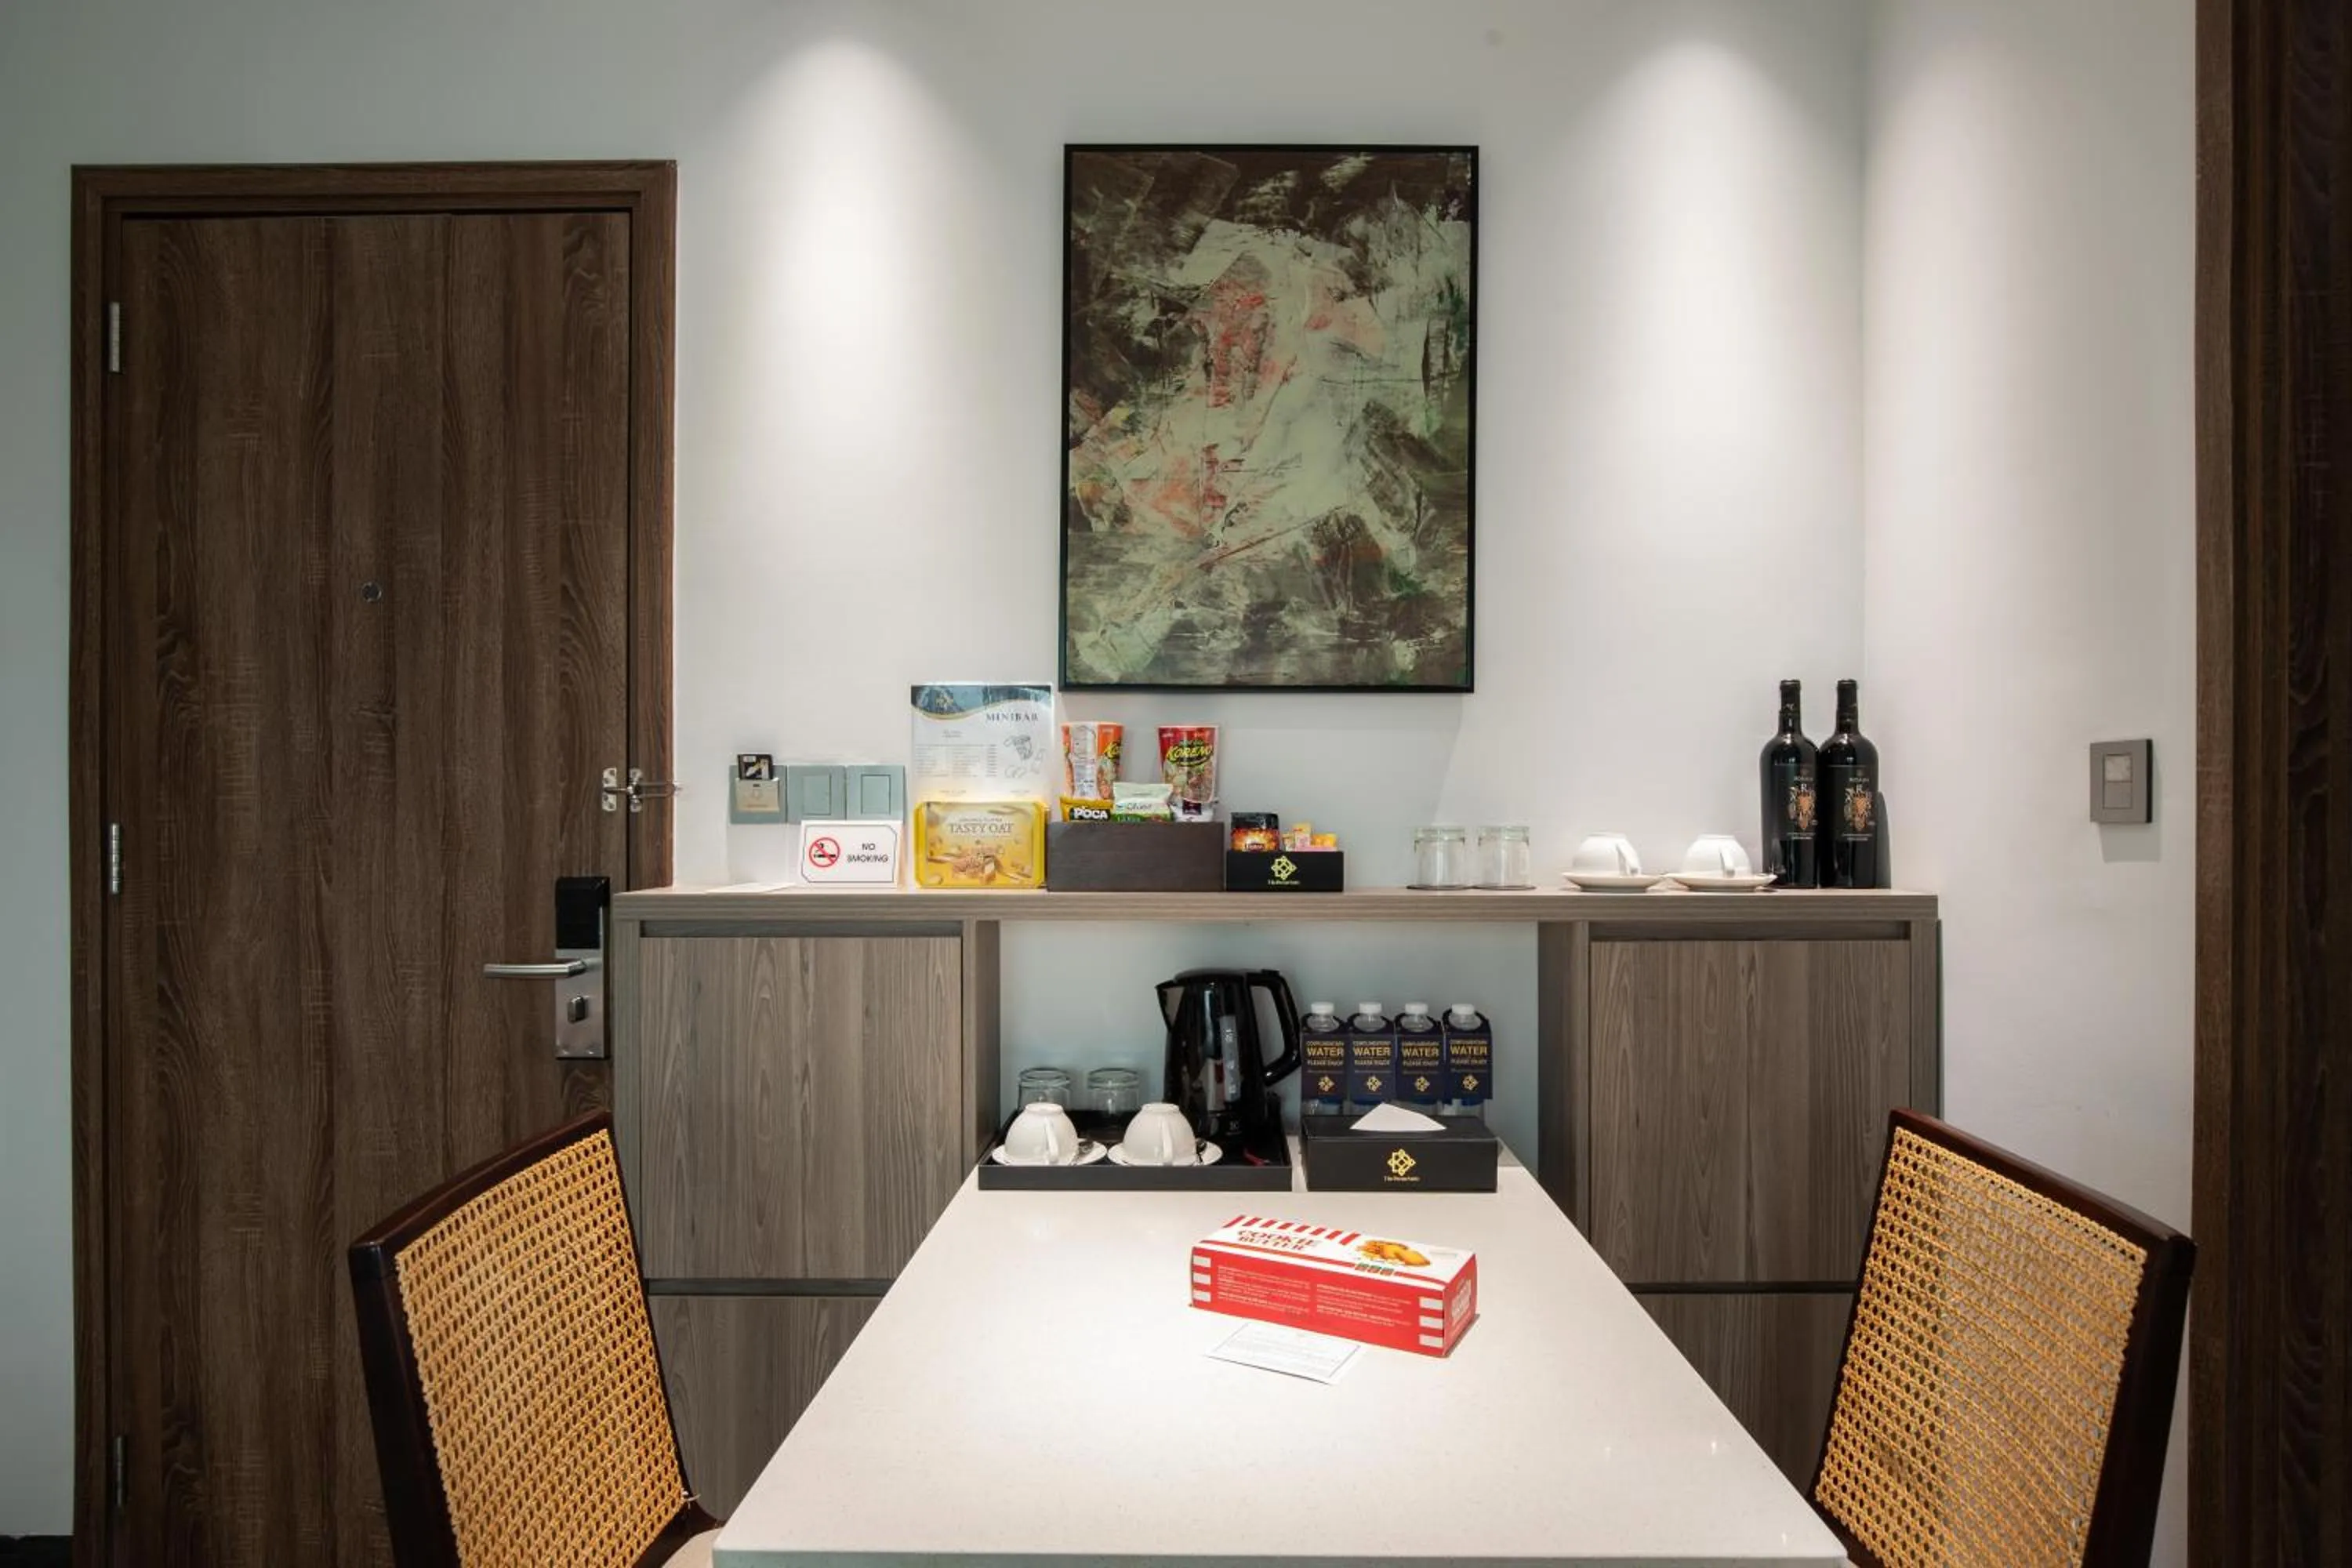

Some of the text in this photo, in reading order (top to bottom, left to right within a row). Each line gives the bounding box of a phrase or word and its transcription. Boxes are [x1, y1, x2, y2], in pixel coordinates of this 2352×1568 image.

[985, 712, 1039, 722] MINIBAR
[948, 822, 1014, 833] TASTY OAT
[847, 854, 888, 863] SMOKING
[1307, 1047, 1345, 1057] WATER
[1353, 1047, 1391, 1056] WATER
[1402, 1047, 1439, 1057] WATER
[1450, 1044, 1487, 1055] WATER
